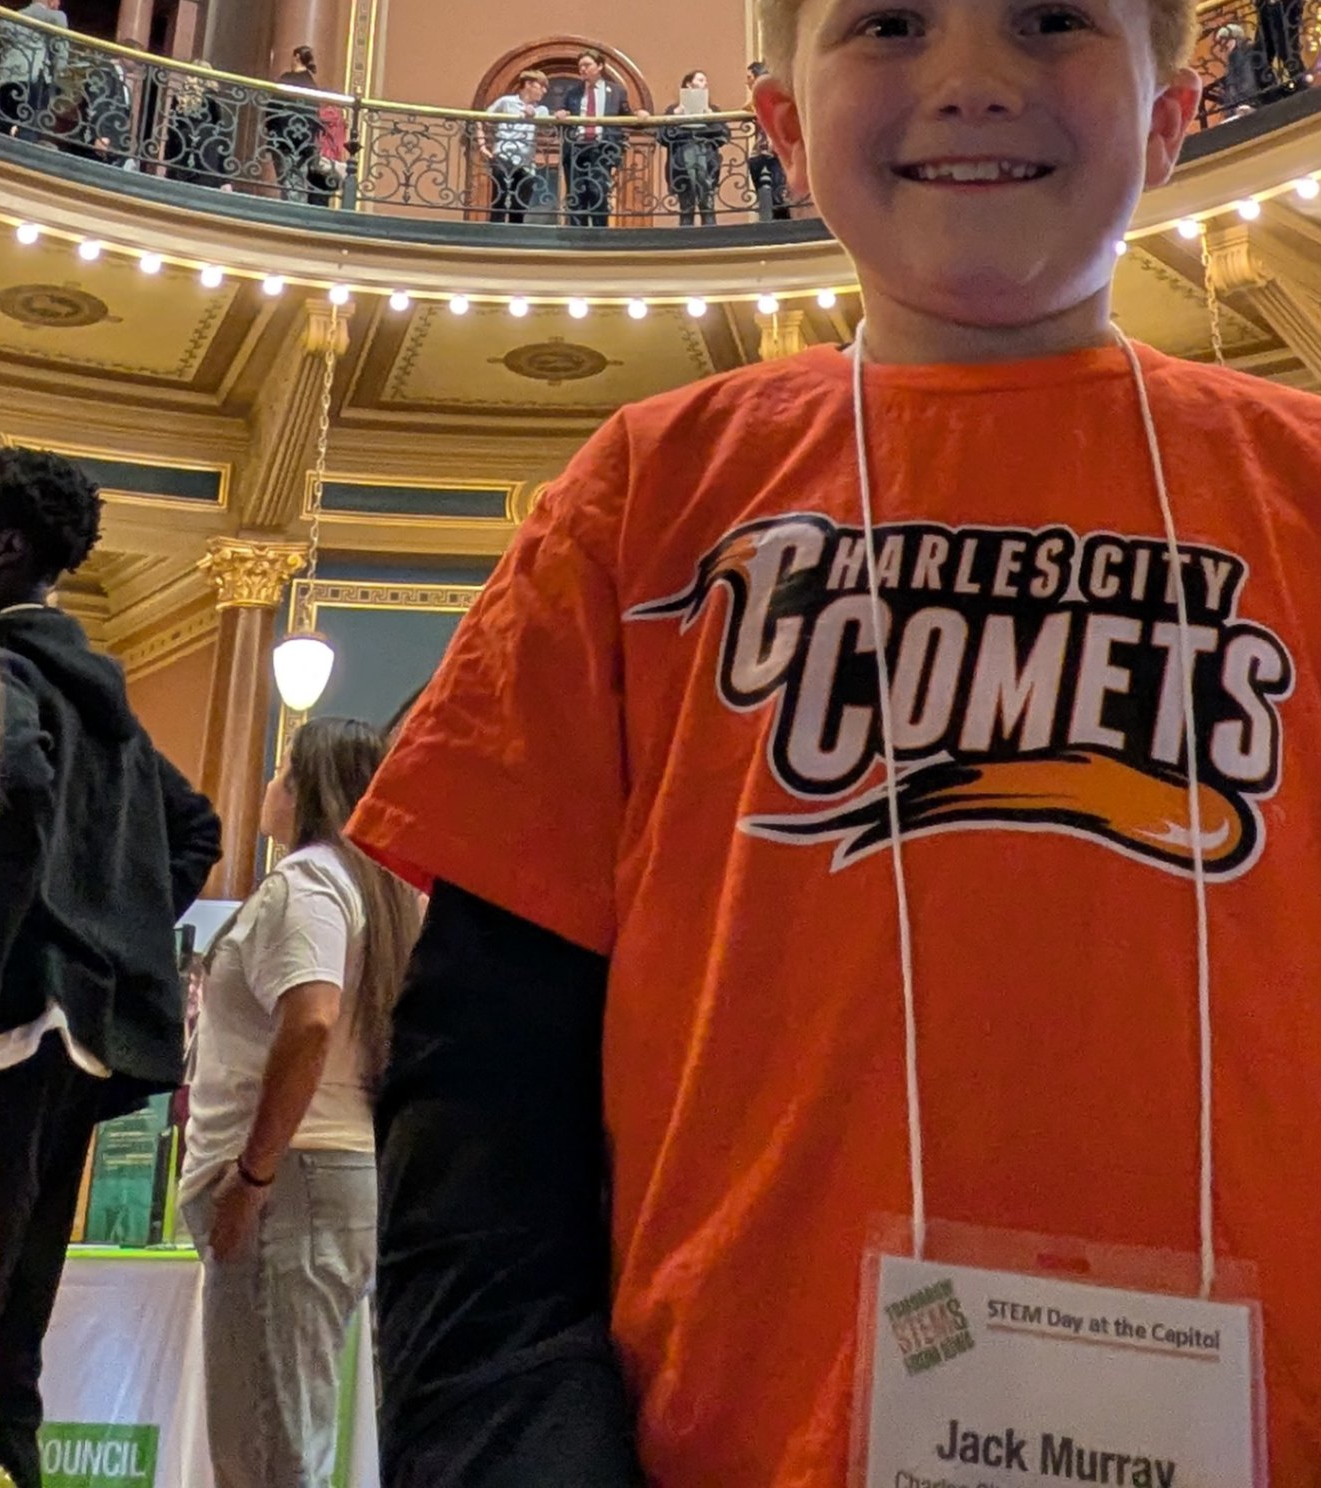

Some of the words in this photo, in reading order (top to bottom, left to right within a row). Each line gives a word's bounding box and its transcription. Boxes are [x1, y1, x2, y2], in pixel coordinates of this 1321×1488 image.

[734, 520, 1065, 694] CHARLES
[1085, 542, 1235, 612] CITY
[785, 595, 1284, 784] COMETS
[987, 1299, 1042, 1325] STEM
[1047, 1307, 1084, 1333] Day
[1089, 1315, 1109, 1333] at
[1114, 1315, 1147, 1339] the
[1151, 1323, 1221, 1350] Capitol
[39, 1438, 146, 1478] OUNCIL
[935, 1419, 1030, 1472] Jack
[1040, 1432, 1177, 1488] Murray
